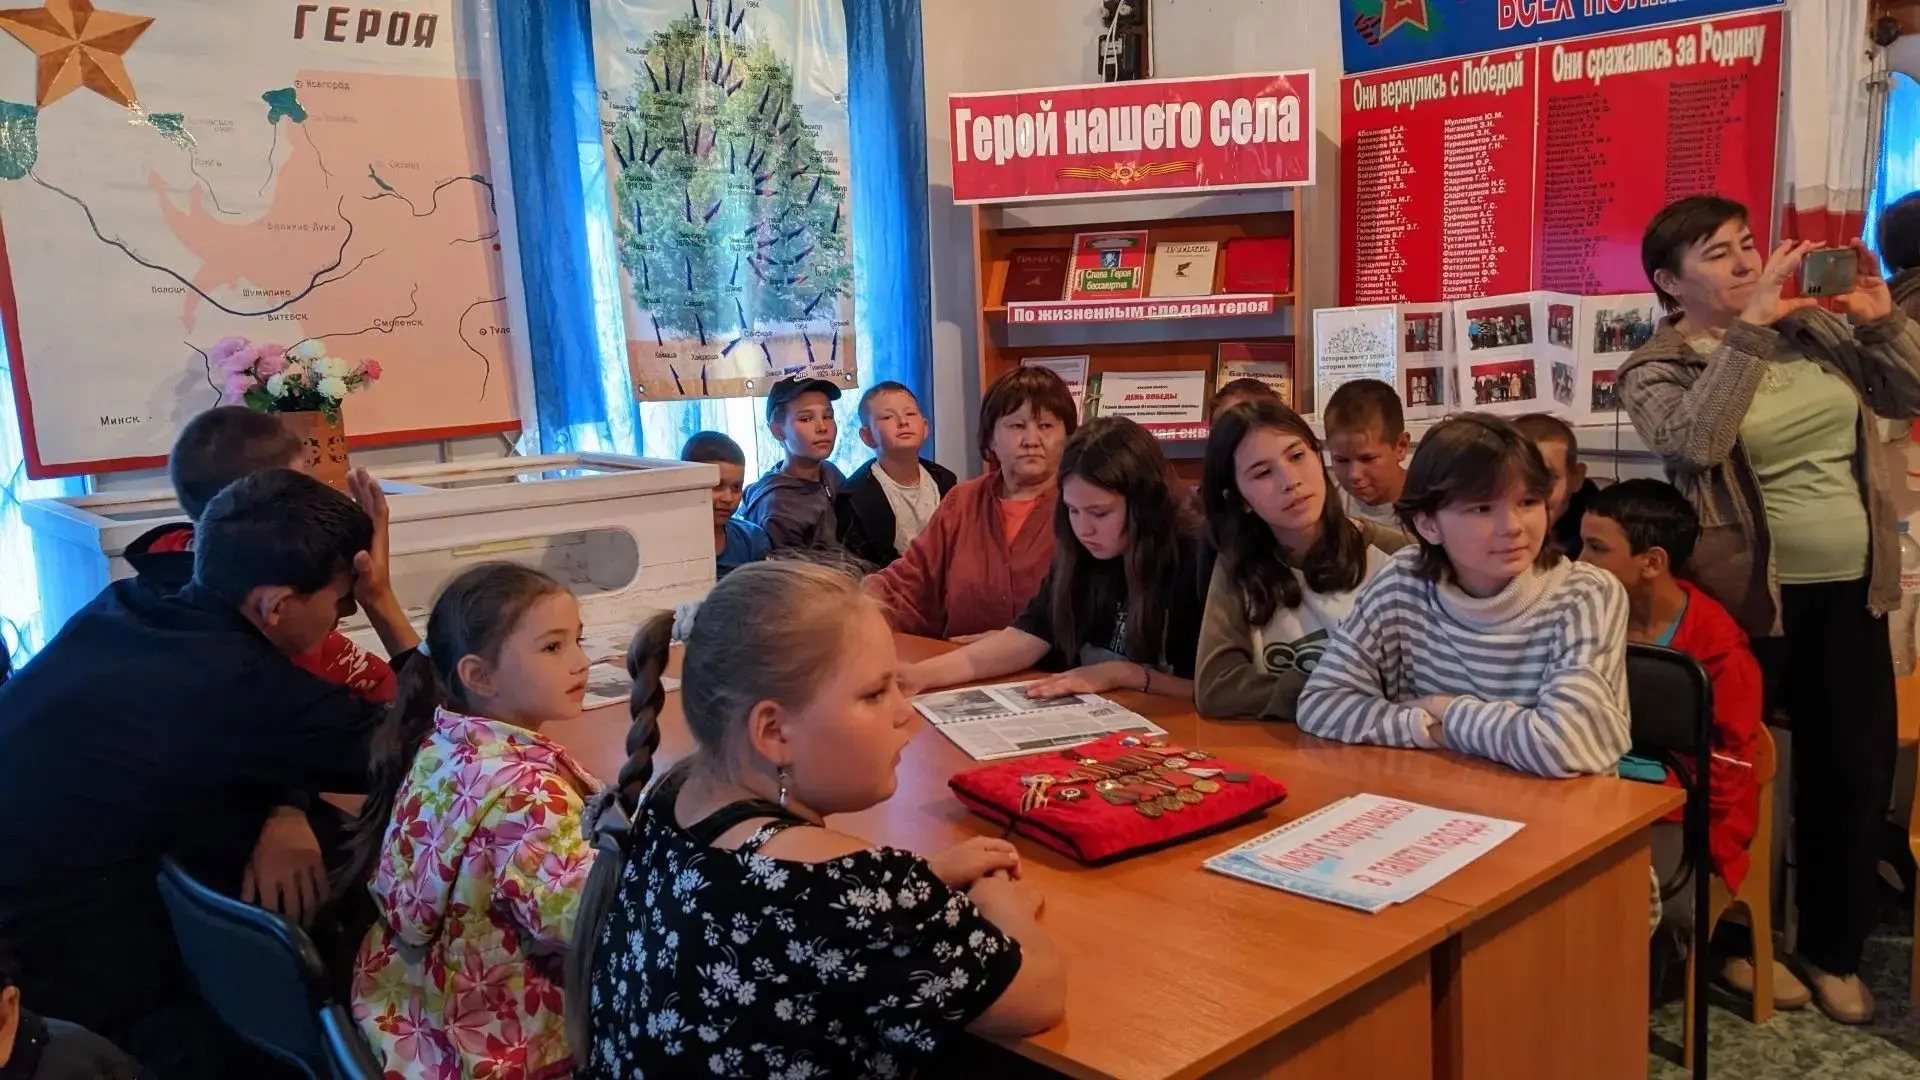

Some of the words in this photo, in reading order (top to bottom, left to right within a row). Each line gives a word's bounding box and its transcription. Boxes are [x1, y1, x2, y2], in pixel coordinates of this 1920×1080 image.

[293, 4, 439, 48] ГЕРОЯ
[1552, 45, 1583, 82] Они
[1586, 39, 1672, 85] сражались
[1676, 35, 1696, 64] за
[1700, 23, 1766, 67] Родину
[306, 79, 350, 91] Новгород
[1353, 80, 1377, 111] Они
[1381, 73, 1446, 112] вернулись
[1450, 70, 1459, 96] с
[1463, 52, 1523, 96] Победой
[1485, 112, 1503, 120] Ю.М.
[955, 99, 1058, 165] Герой
[1065, 101, 1202, 155] нашего
[1210, 95, 1301, 146] села
[313, 223, 336, 232] Луки
[1086, 270, 1108, 279] Слава
[1110, 269, 1132, 278] Героя
[151, 286, 187, 294] Полоцк
[1014, 308, 1035, 322] По
[1037, 306, 1143, 321] жизненным
[1147, 303, 1215, 317] следам
[1219, 300, 1269, 314] героя
[373, 319, 424, 327] Смоленск
[1124, 393, 1144, 401] ДЕНЬ
[100, 415, 141, 426] Минск
[1367, 845, 1446, 877] памяти
[1416, 818, 1494, 846] народа
